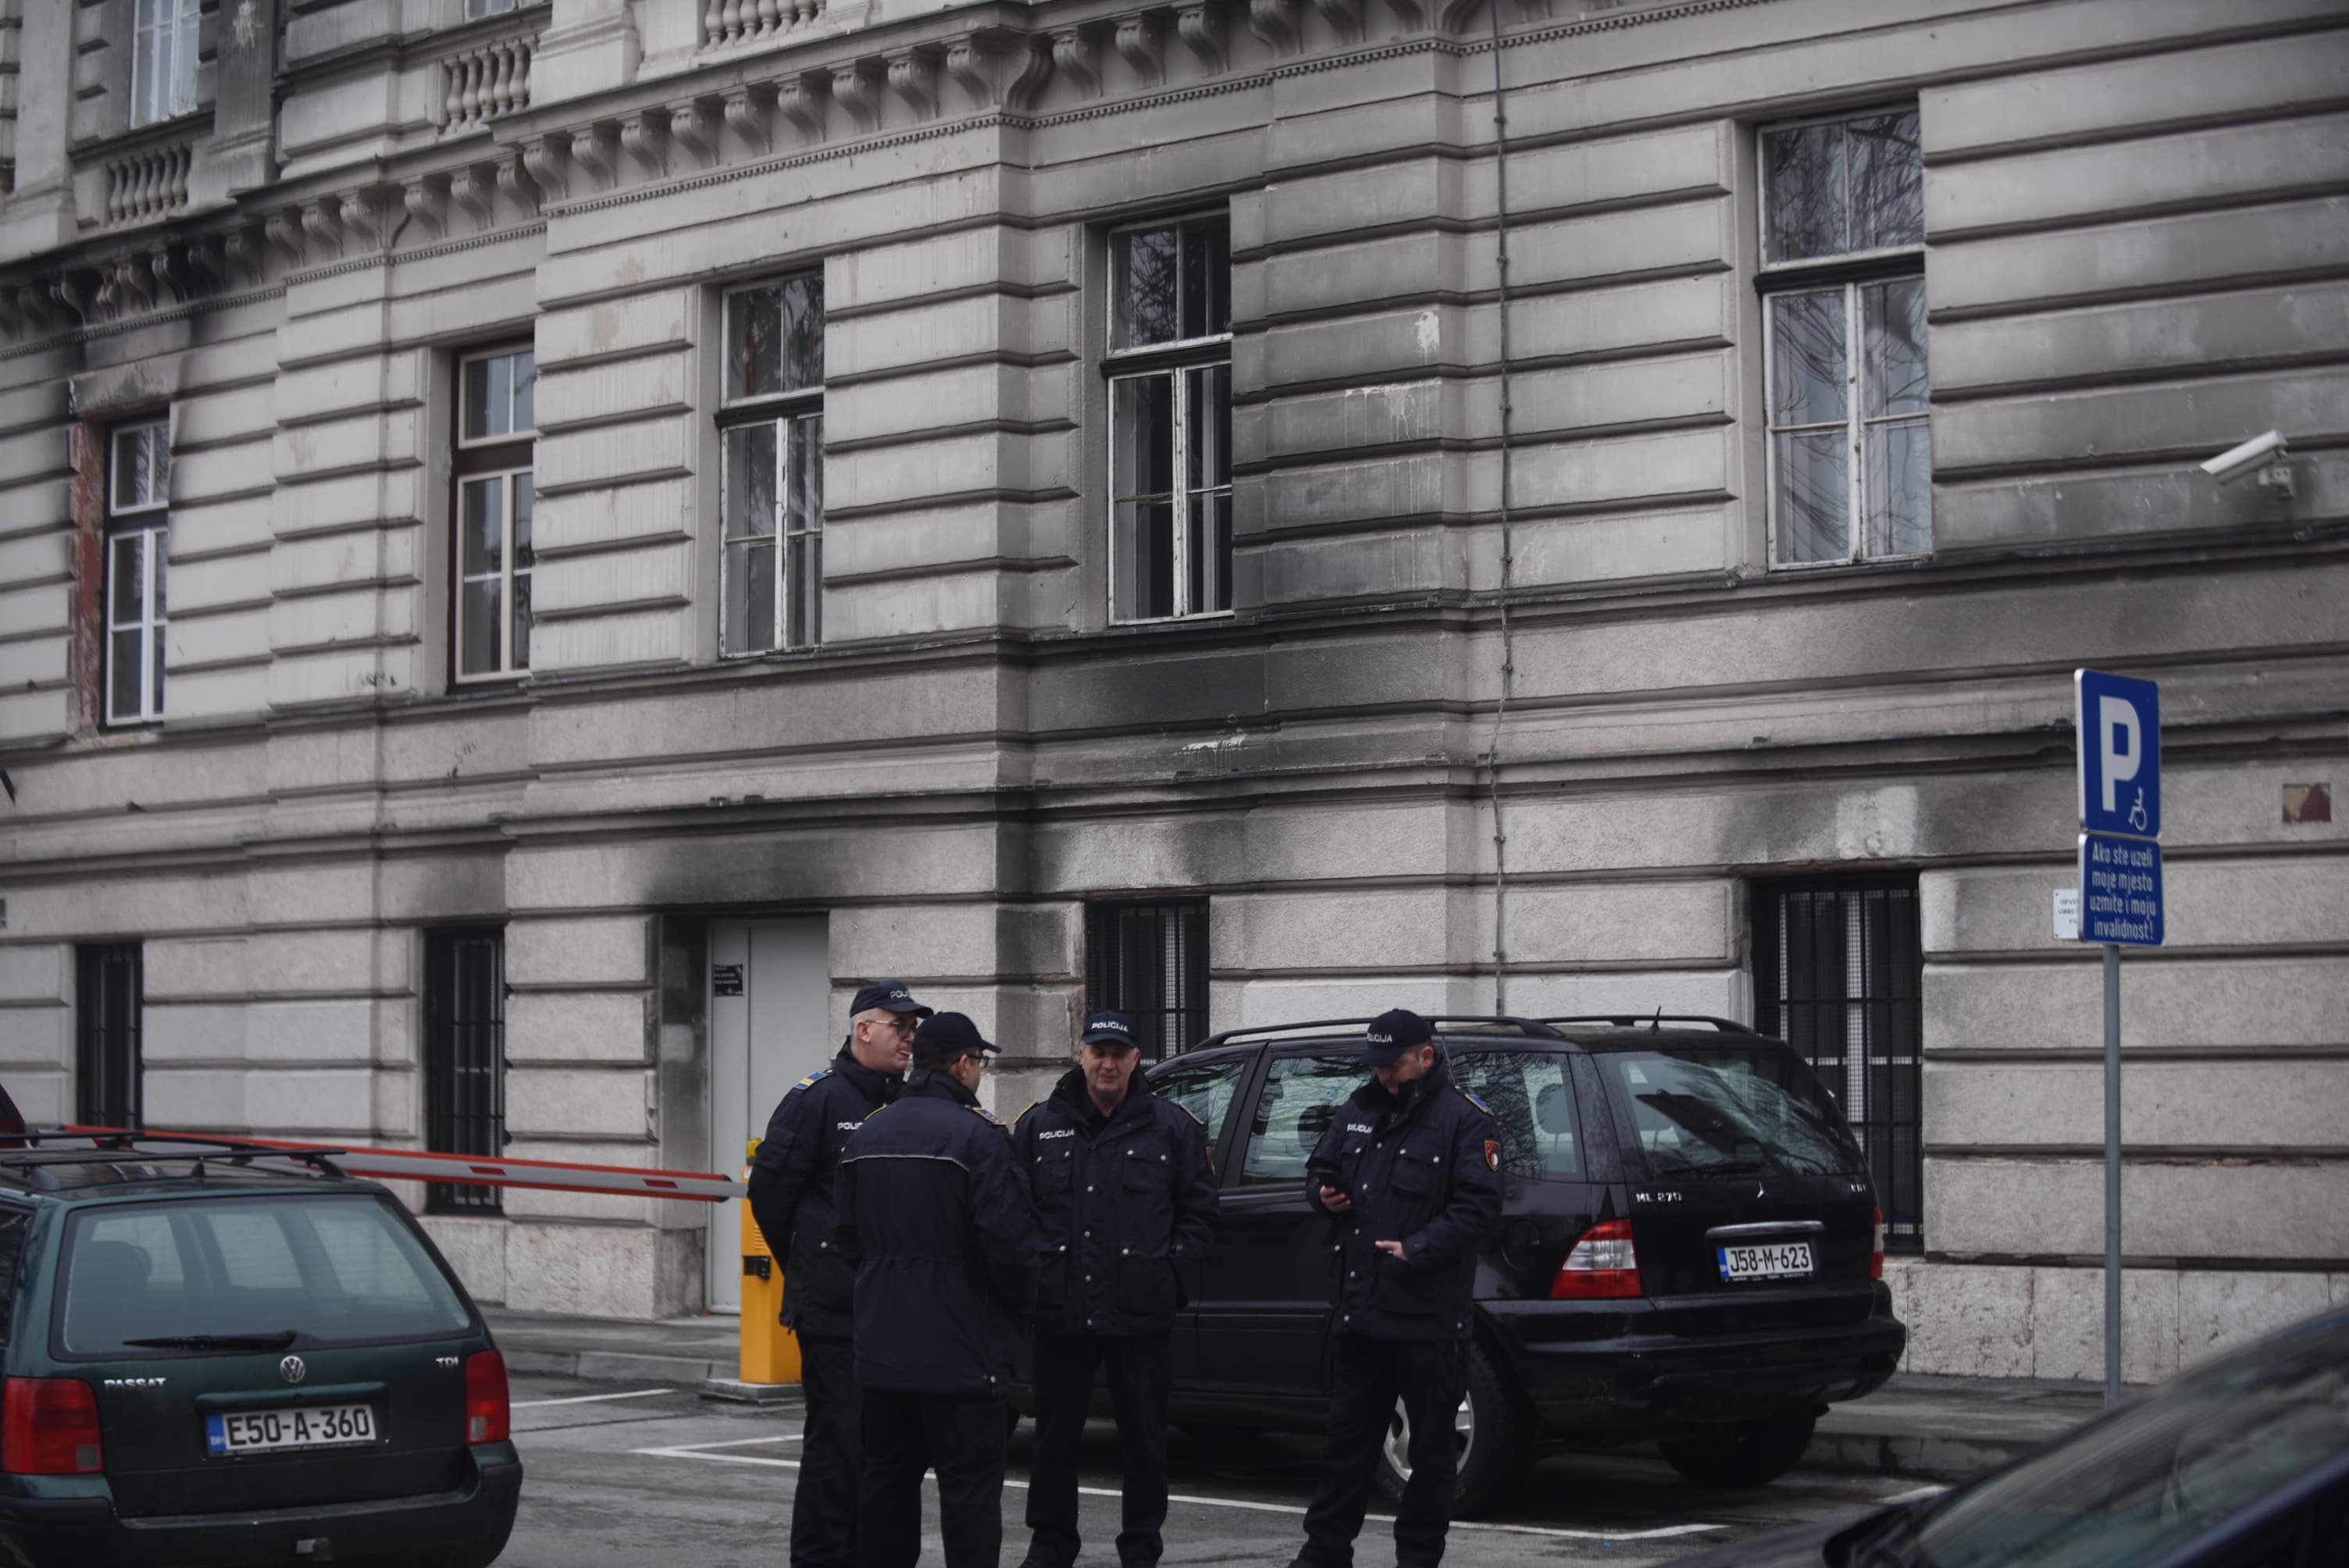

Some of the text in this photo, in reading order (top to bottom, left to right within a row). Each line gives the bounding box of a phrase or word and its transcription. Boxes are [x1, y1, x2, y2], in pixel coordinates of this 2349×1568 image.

[2099, 694, 2141, 812] P
[2092, 841, 2153, 868] Ako ste uzeli
[2092, 868, 2153, 896] moje mjesto
[2089, 893, 2156, 921] uzmite i moju
[2094, 916, 2154, 940] invalidnost!
[1091, 1020, 1129, 1033] POLICIJA
[1039, 1129, 1075, 1141] POLICIJA
[1635, 1191, 1682, 1203] ML 270
[1730, 1246, 1809, 1272] J58-M-623
[435, 1356, 459, 1368] TDI
[103, 1377, 167, 1391] PASSAT
[226, 1408, 370, 1445] E50-A-360
